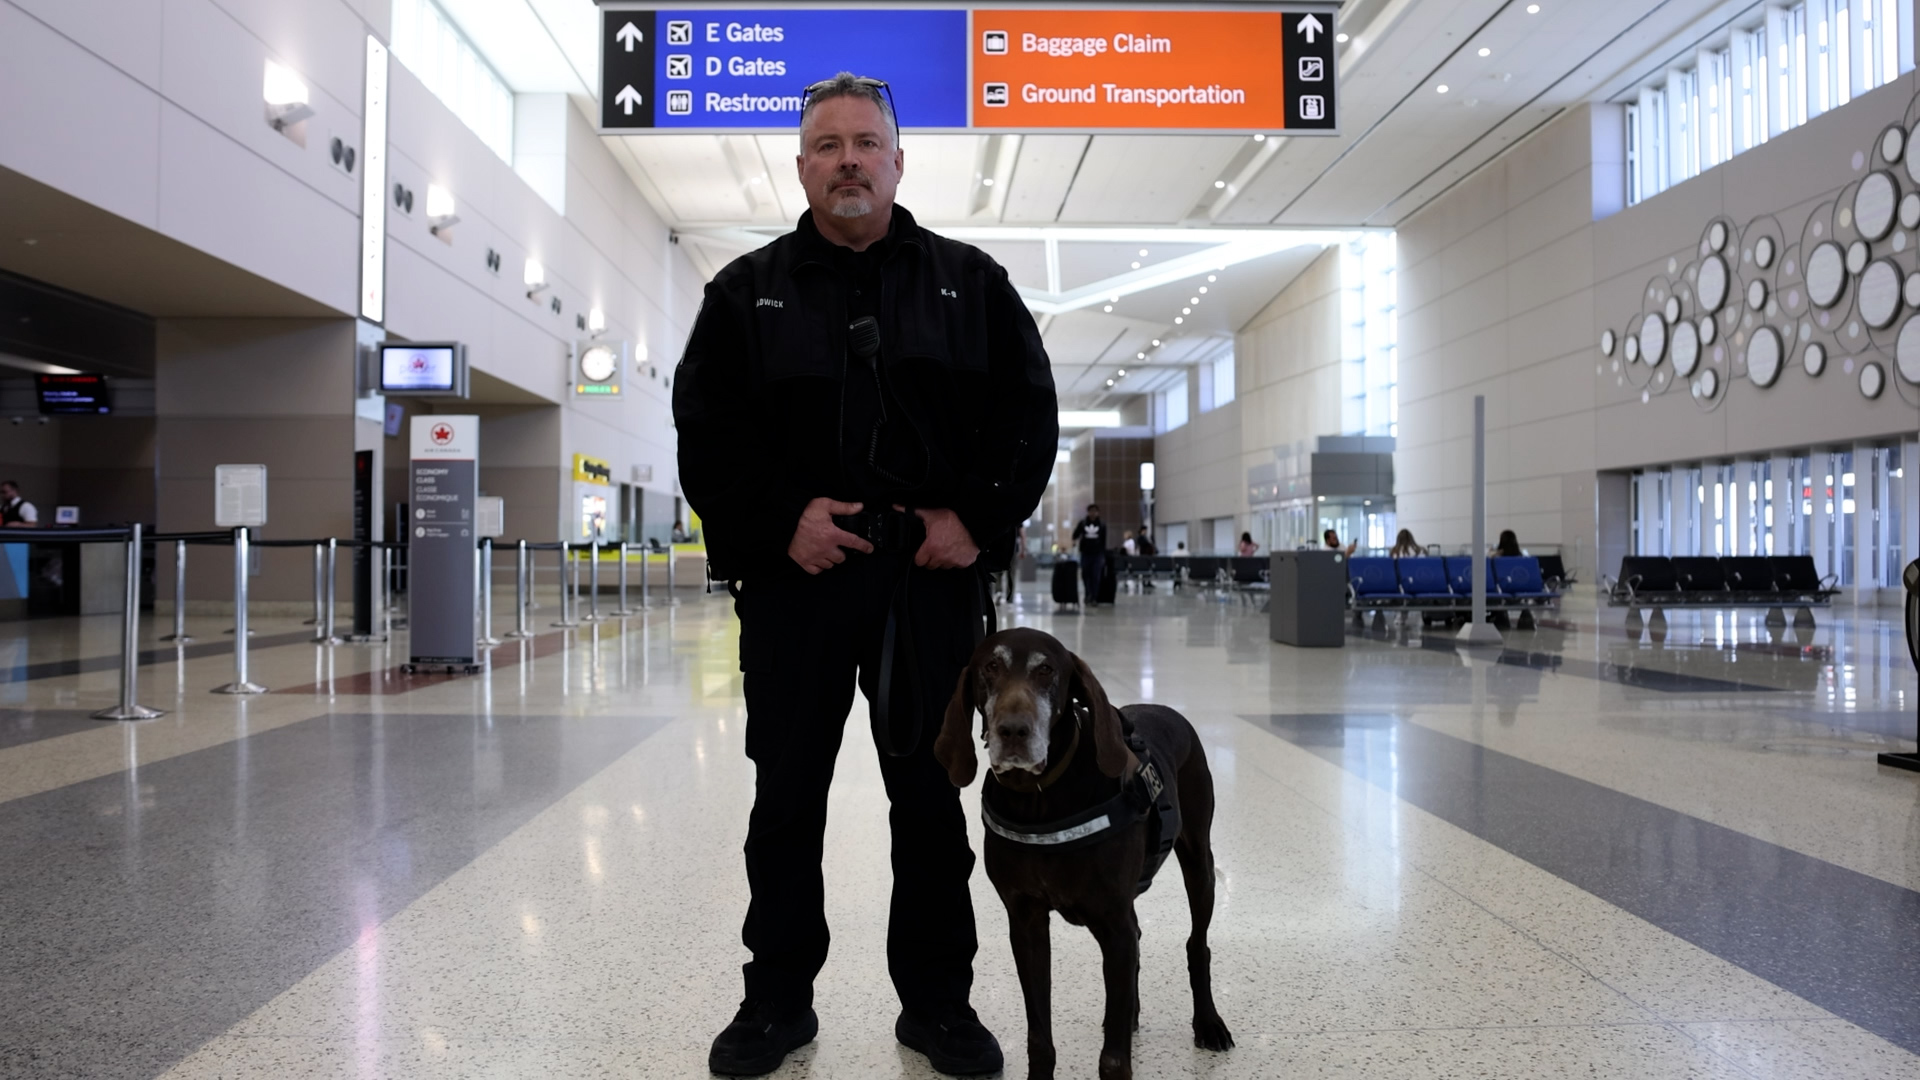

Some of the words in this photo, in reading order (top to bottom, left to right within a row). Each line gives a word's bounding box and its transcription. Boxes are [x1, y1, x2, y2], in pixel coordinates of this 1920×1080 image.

[706, 22, 721, 43] E
[726, 22, 785, 43] Gates
[1022, 32, 1108, 57] Baggage
[1113, 33, 1171, 53] Claim
[706, 56, 722, 77] D
[728, 56, 787, 77] Gates
[1021, 83, 1096, 103] Ground
[1102, 83, 1245, 108] Transportation
